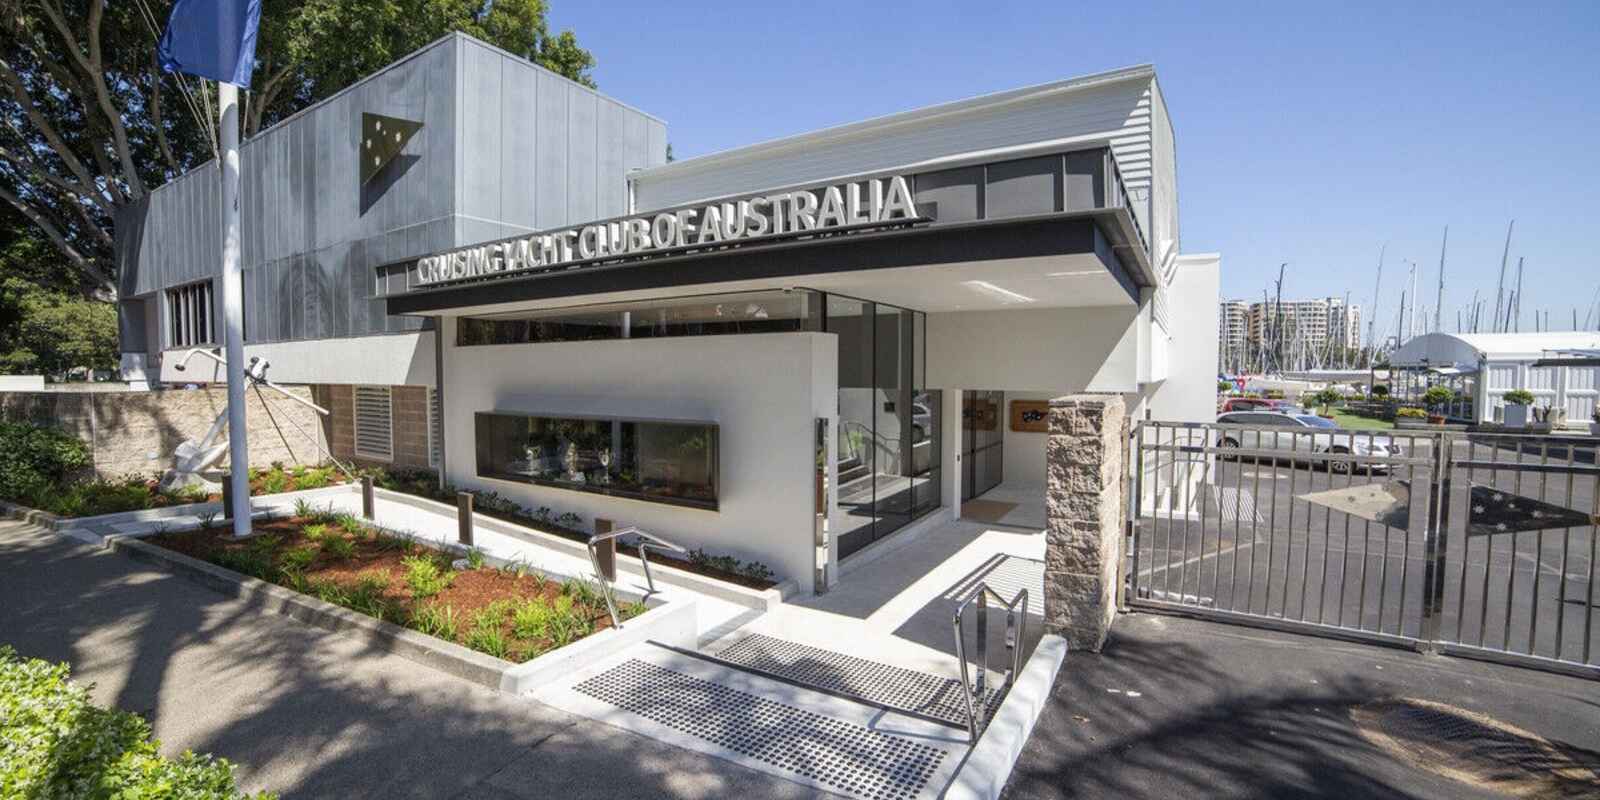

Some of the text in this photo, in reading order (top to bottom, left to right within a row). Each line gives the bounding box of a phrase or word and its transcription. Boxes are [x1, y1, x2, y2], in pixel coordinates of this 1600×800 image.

[417, 175, 918, 284] CRUISING YACHT CLUB OF AUSTRALIA
